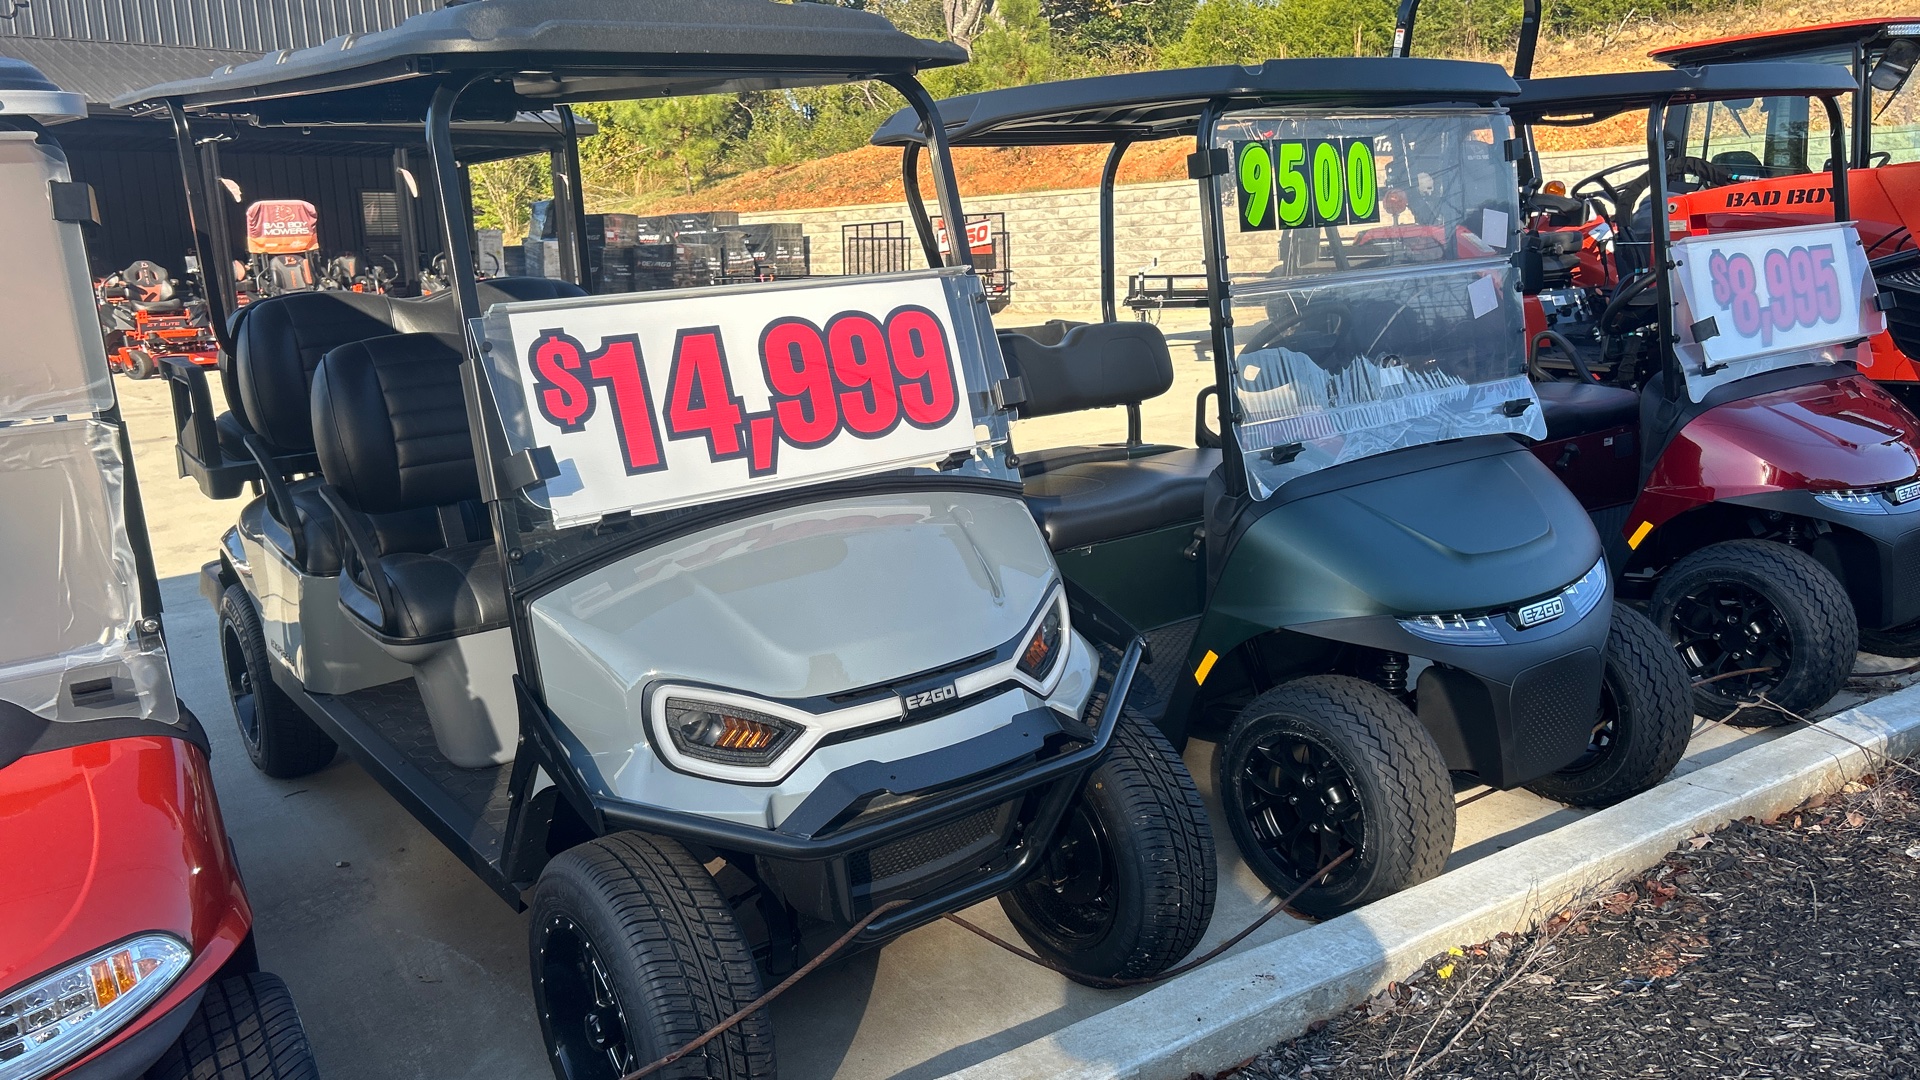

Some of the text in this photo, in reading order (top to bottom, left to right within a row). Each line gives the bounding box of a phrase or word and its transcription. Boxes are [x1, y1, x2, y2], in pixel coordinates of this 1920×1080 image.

[1239, 141, 1376, 227] 9500
[1725, 190, 1781, 208] BAD
[264, 227, 310, 236] MOWERS
[1709, 244, 1841, 348] $8,995
[528, 304, 960, 478] $14,999
